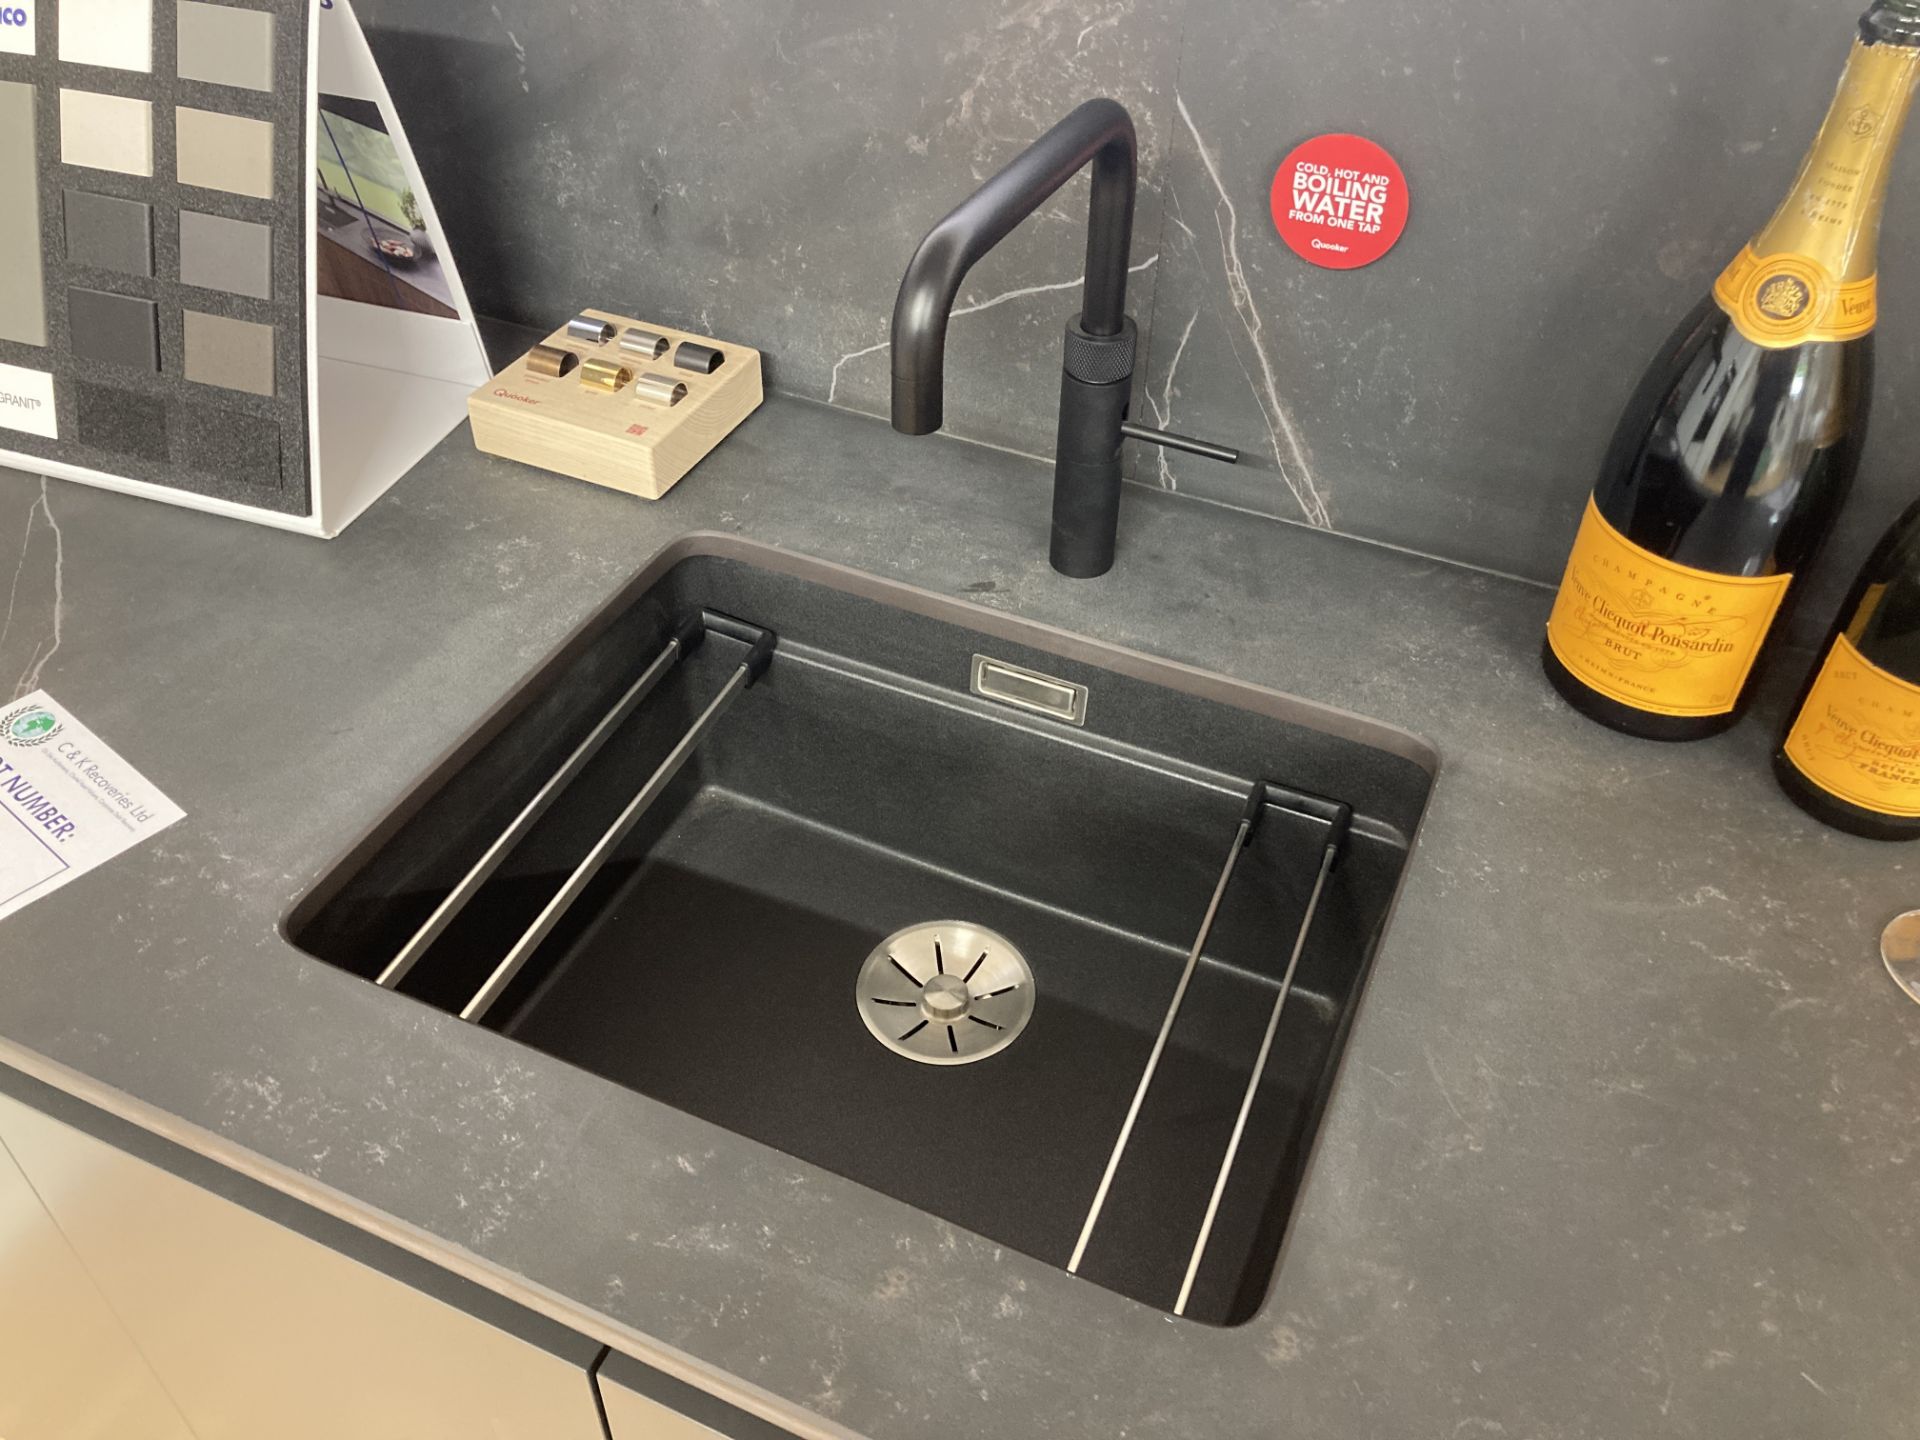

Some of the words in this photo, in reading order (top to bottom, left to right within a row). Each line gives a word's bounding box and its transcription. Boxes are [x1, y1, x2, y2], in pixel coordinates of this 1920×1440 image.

[1296, 161, 1331, 178] COLD,
[1334, 168, 1360, 181] HOT
[1361, 173, 1390, 186] AND
[1293, 171, 1387, 204] BOILING
[1293, 189, 1384, 225] WATER
[1288, 209, 1325, 225] FROM
[1327, 216, 1355, 230] ONE
[1358, 221, 1381, 234] TAP
[1311, 238, 1349, 253] Quooker
[493, 388, 541, 405] Quooker
[1592, 553, 1718, 615] CHAMPAGNE
[1569, 566, 1592, 601] Veuve
[1592, 595, 1650, 639] Clicquot
[1651, 626, 1735, 654] Ponsardin
[1603, 638, 1643, 661] BRUT
[1826, 704, 1858, 735] Veuve
[57, 742, 74, 753] C
[66, 750, 81, 761] &
[75, 757, 92, 769] K
[83, 764, 134, 810] Recoveries
[1, 774, 75, 843] NUMBER:
[130, 805, 156, 824] Ltd
